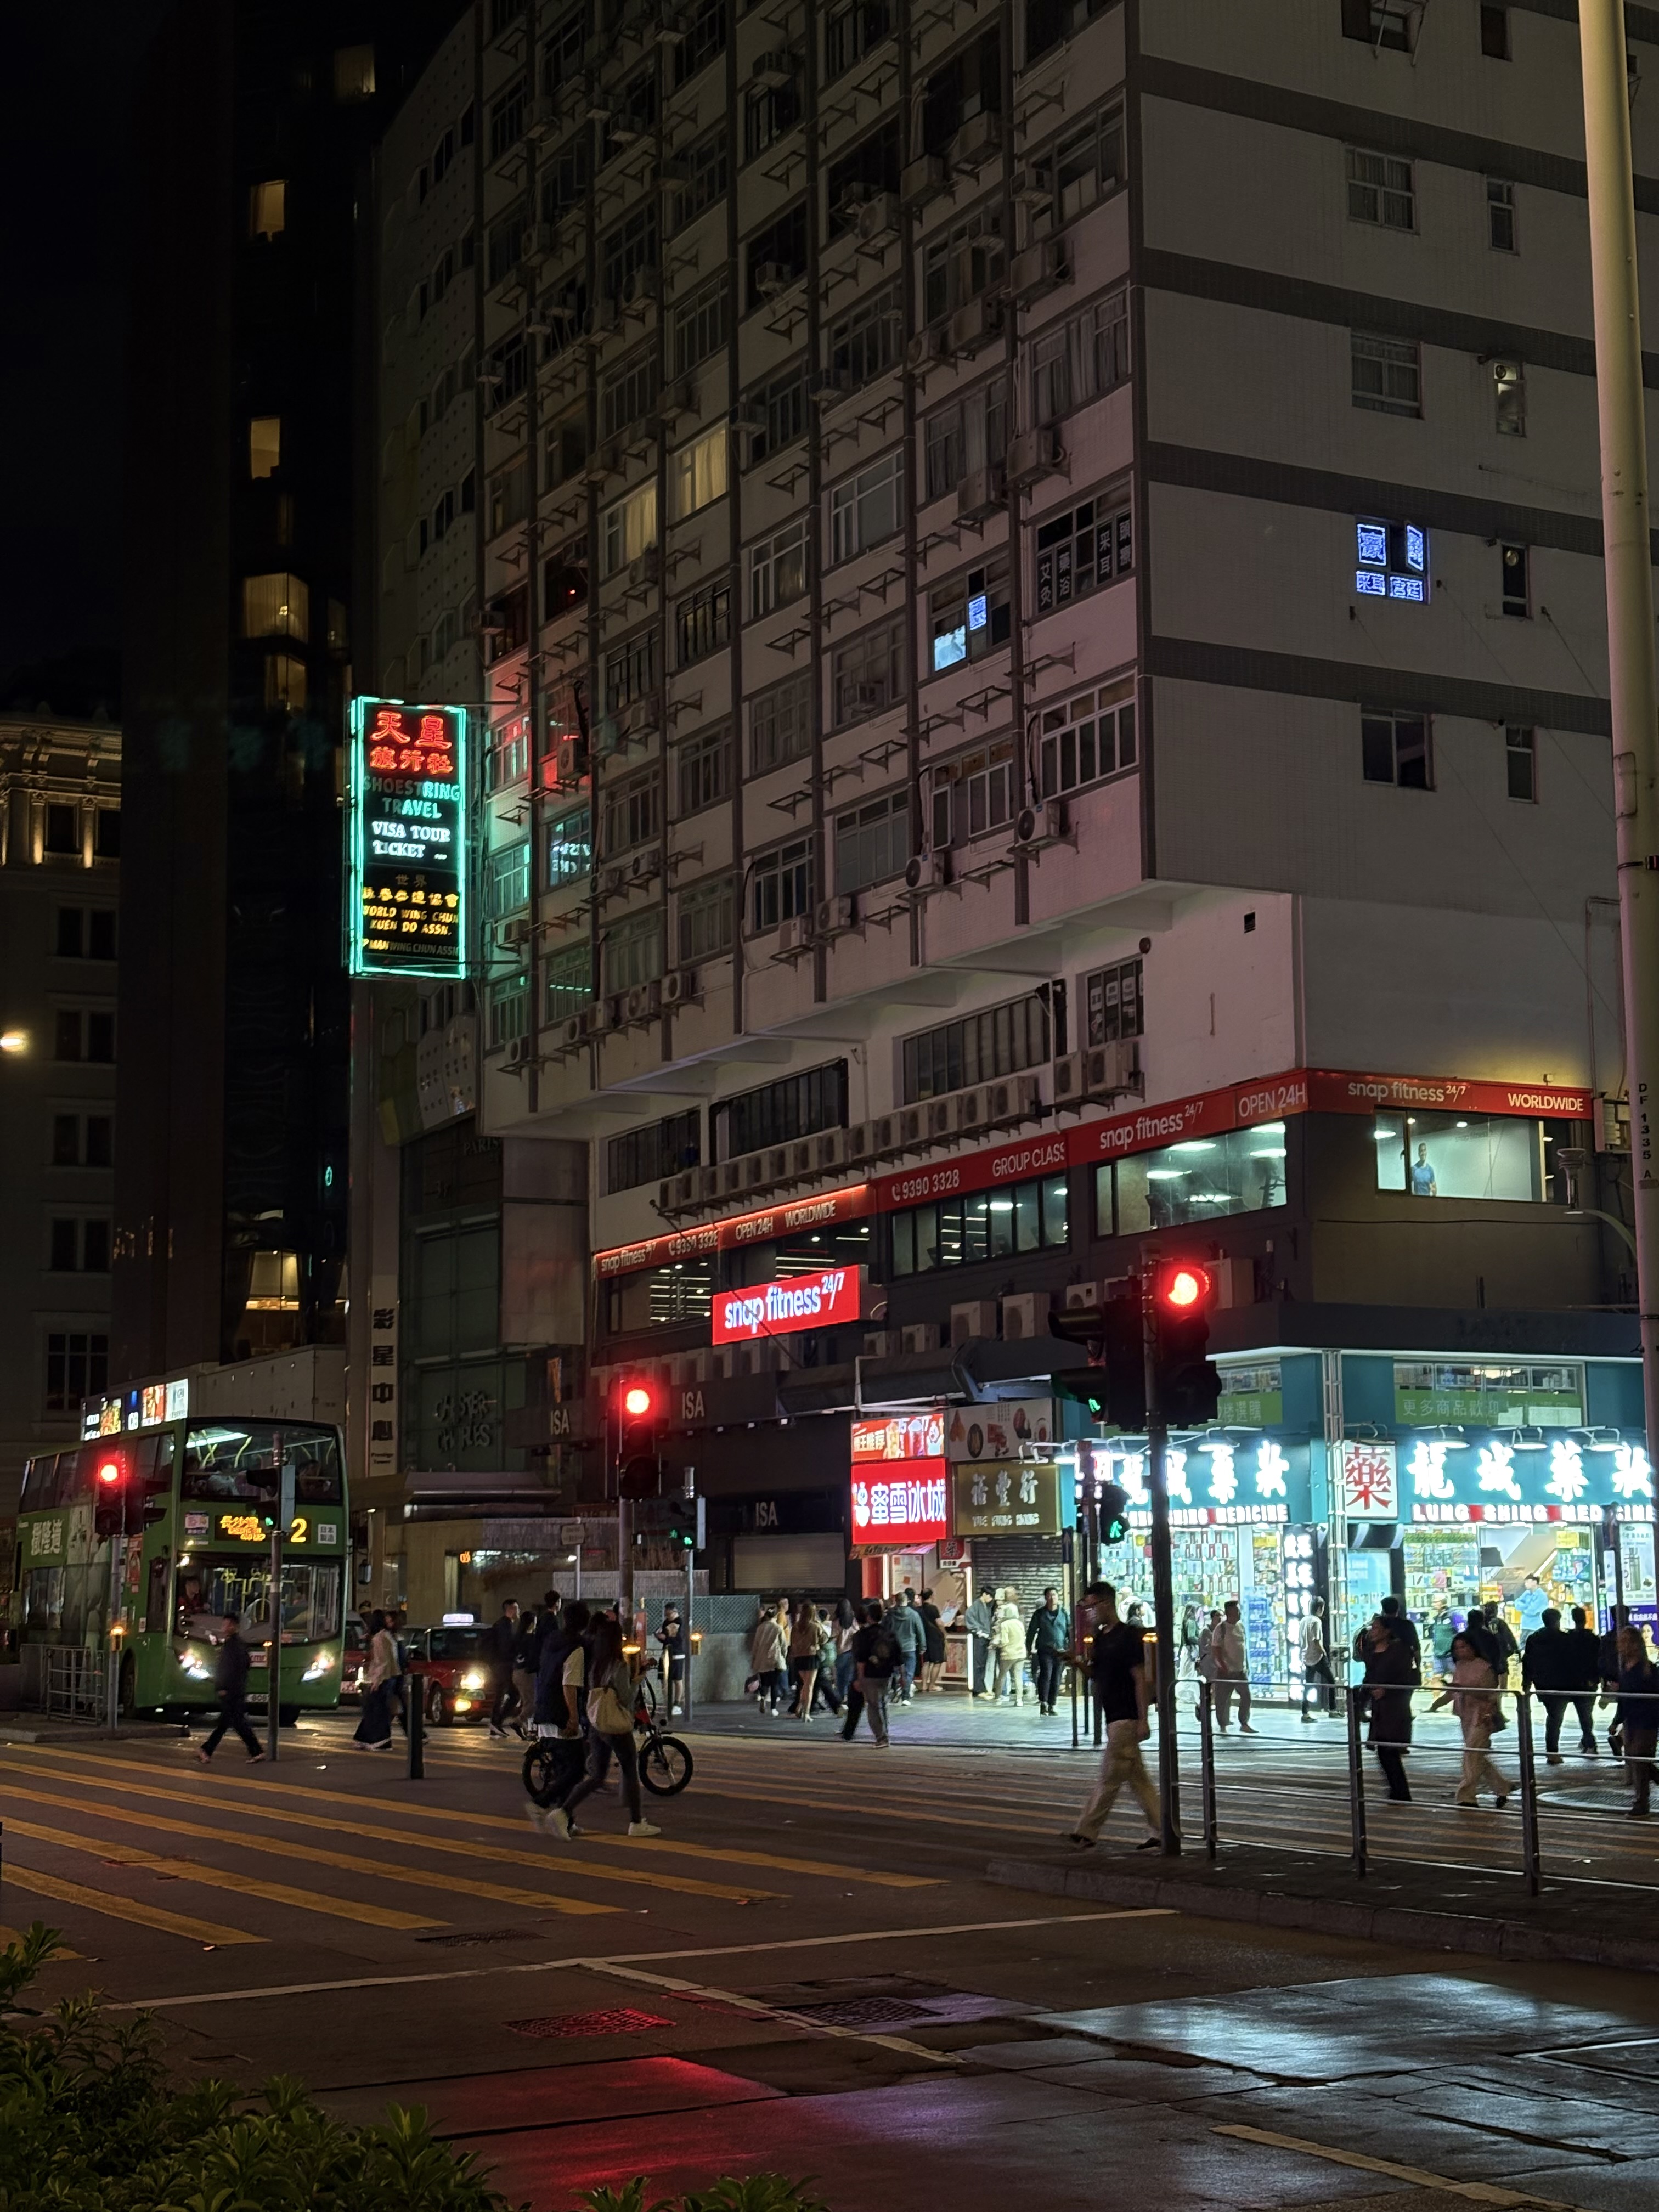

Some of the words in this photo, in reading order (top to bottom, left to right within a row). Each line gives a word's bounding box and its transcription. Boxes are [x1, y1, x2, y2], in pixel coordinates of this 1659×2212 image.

[1099, 529, 1111, 574] 采耳
[370, 711, 453, 750] 天星
[370, 746, 453, 774] 旅行社
[364, 775, 460, 801] SHOESTRING
[382, 797, 442, 818] TRAVEL
[372, 821, 407, 838] VISA
[410, 825, 450, 842] TOUR
[373, 840, 426, 858] TICKET
[395, 874, 427, 888] 世界
[400, 909, 428, 921] WING
[402, 921, 417, 932] DO
[390, 941, 412, 952] WING
[413, 943, 436, 954] CHUN
[1238, 1092, 1276, 1118] OPEN
[1278, 1083, 1307, 1109] 24H
[1348, 1080, 1388, 1104] snap
[1391, 1081, 1445, 1103] fitness
[1446, 1085, 1466, 1103] 24/7
[1508, 1093, 1584, 1112] WORLDWIDE
[1099, 1128, 1133, 1150] snap
[1136, 1111, 1183, 1140] fitness
[1184, 1101, 1204, 1125] 24/7
[992, 1156, 1030, 1177] GROUP
[1031, 1142, 1065, 1168] CLASS
[902, 1179, 929, 1200] 9390
[932, 1169, 960, 1192] 3328
[736, 1220, 757, 1242] OPEN
[757, 1216, 774, 1236] 24H
[785, 1200, 837, 1228] WORLDWIDE
[601, 1252, 622, 1275] snap
[621, 1247, 646, 1268] fitness
[725, 1297, 764, 1334] snap
[766, 1282, 821, 1319] fitness
[821, 1272, 845, 1310] 24/7
[681, 1390, 705, 1419] ISA
[550, 1408, 570, 1436] ISA
[1345, 1447, 1392, 1510] 藥
[755, 1501, 778, 1527] ISA
[871, 1479, 947, 1525] 蜜雪冰城
[1216, 1503, 1289, 1524] MEDICINE
[1413, 1504, 1470, 1523] LUNG
[1483, 1503, 1548, 1523] SHING
[290, 1518, 307, 1542] 2
